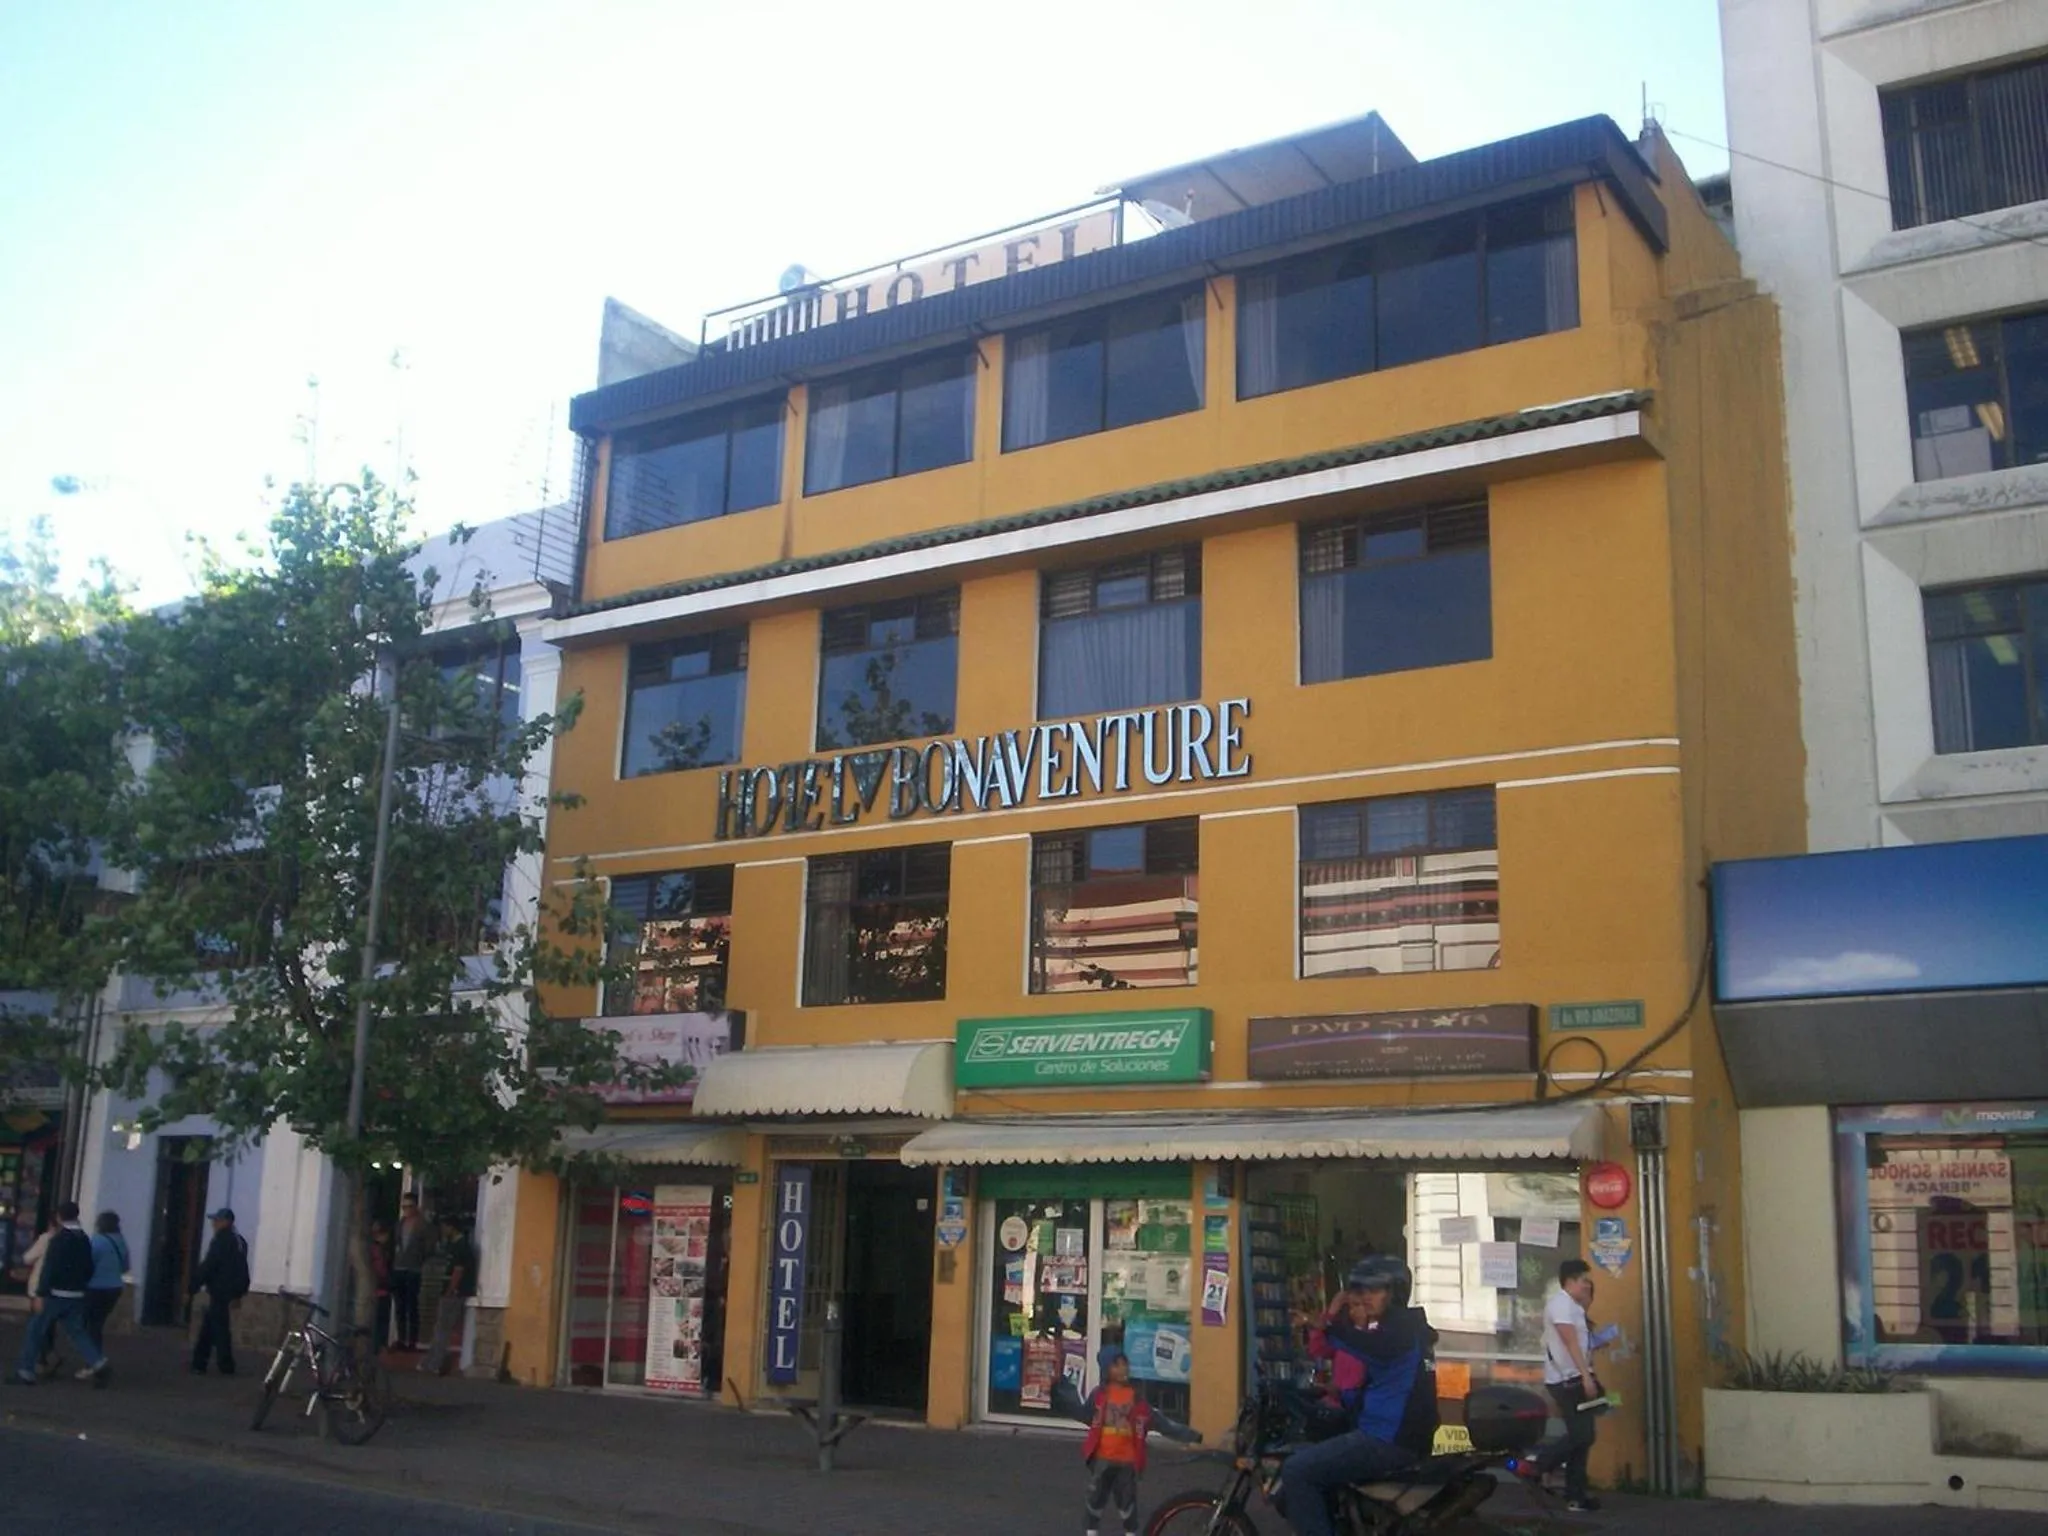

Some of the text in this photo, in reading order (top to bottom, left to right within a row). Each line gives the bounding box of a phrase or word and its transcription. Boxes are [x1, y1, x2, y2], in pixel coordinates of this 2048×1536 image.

[834, 221, 1097, 324] HOTEL
[714, 697, 1251, 840] HOTEL BONAVENTURE
[1006, 1028, 1178, 1055] SERVIENTREGA
[1034, 1056, 1170, 1075] Centro de Soluciones
[775, 1181, 805, 1370] HOTEL
